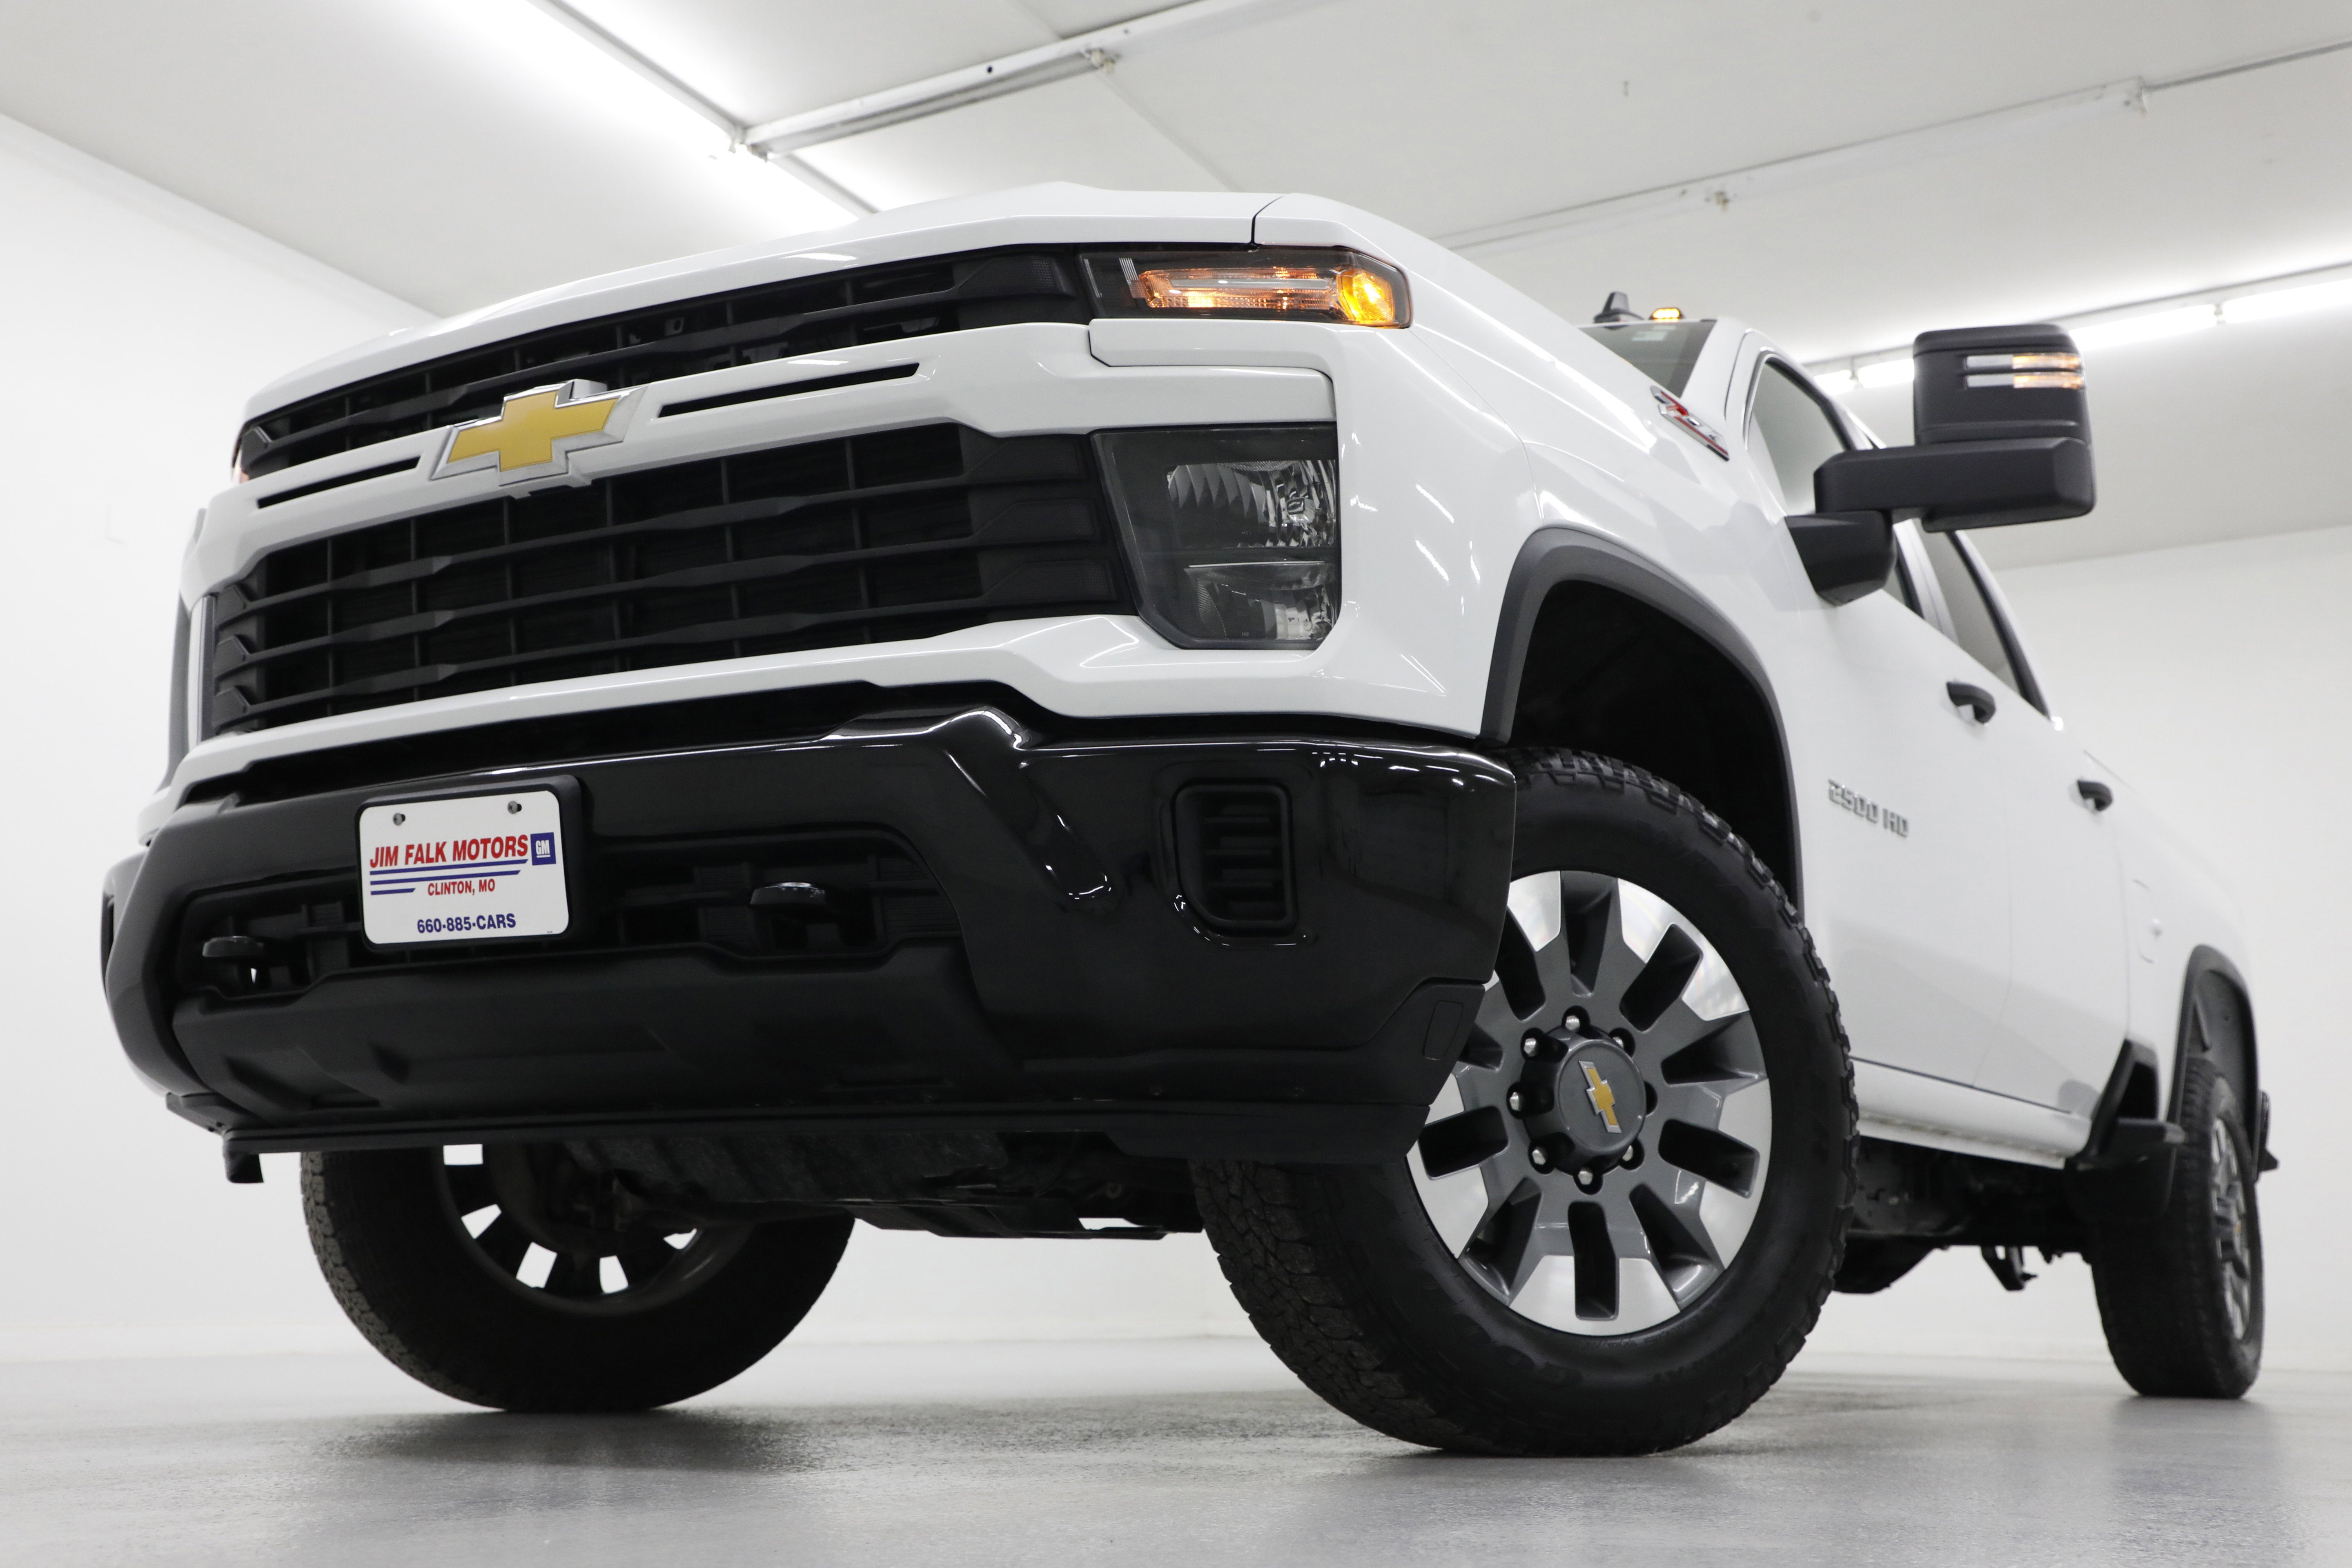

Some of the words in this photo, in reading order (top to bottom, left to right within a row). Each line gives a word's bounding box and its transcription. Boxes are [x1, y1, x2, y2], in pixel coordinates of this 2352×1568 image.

[1828, 778, 1879, 824] 2500
[1882, 807, 1909, 838] HD
[370, 846, 399, 868] JIM
[405, 842, 447, 865] FALK
[452, 834, 528, 862] MOTORS
[535, 840, 550, 855] GM
[428, 880, 475, 896] CLINTON,
[479, 878, 496, 893] MO
[417, 913, 517, 933] 660-885-CARS
